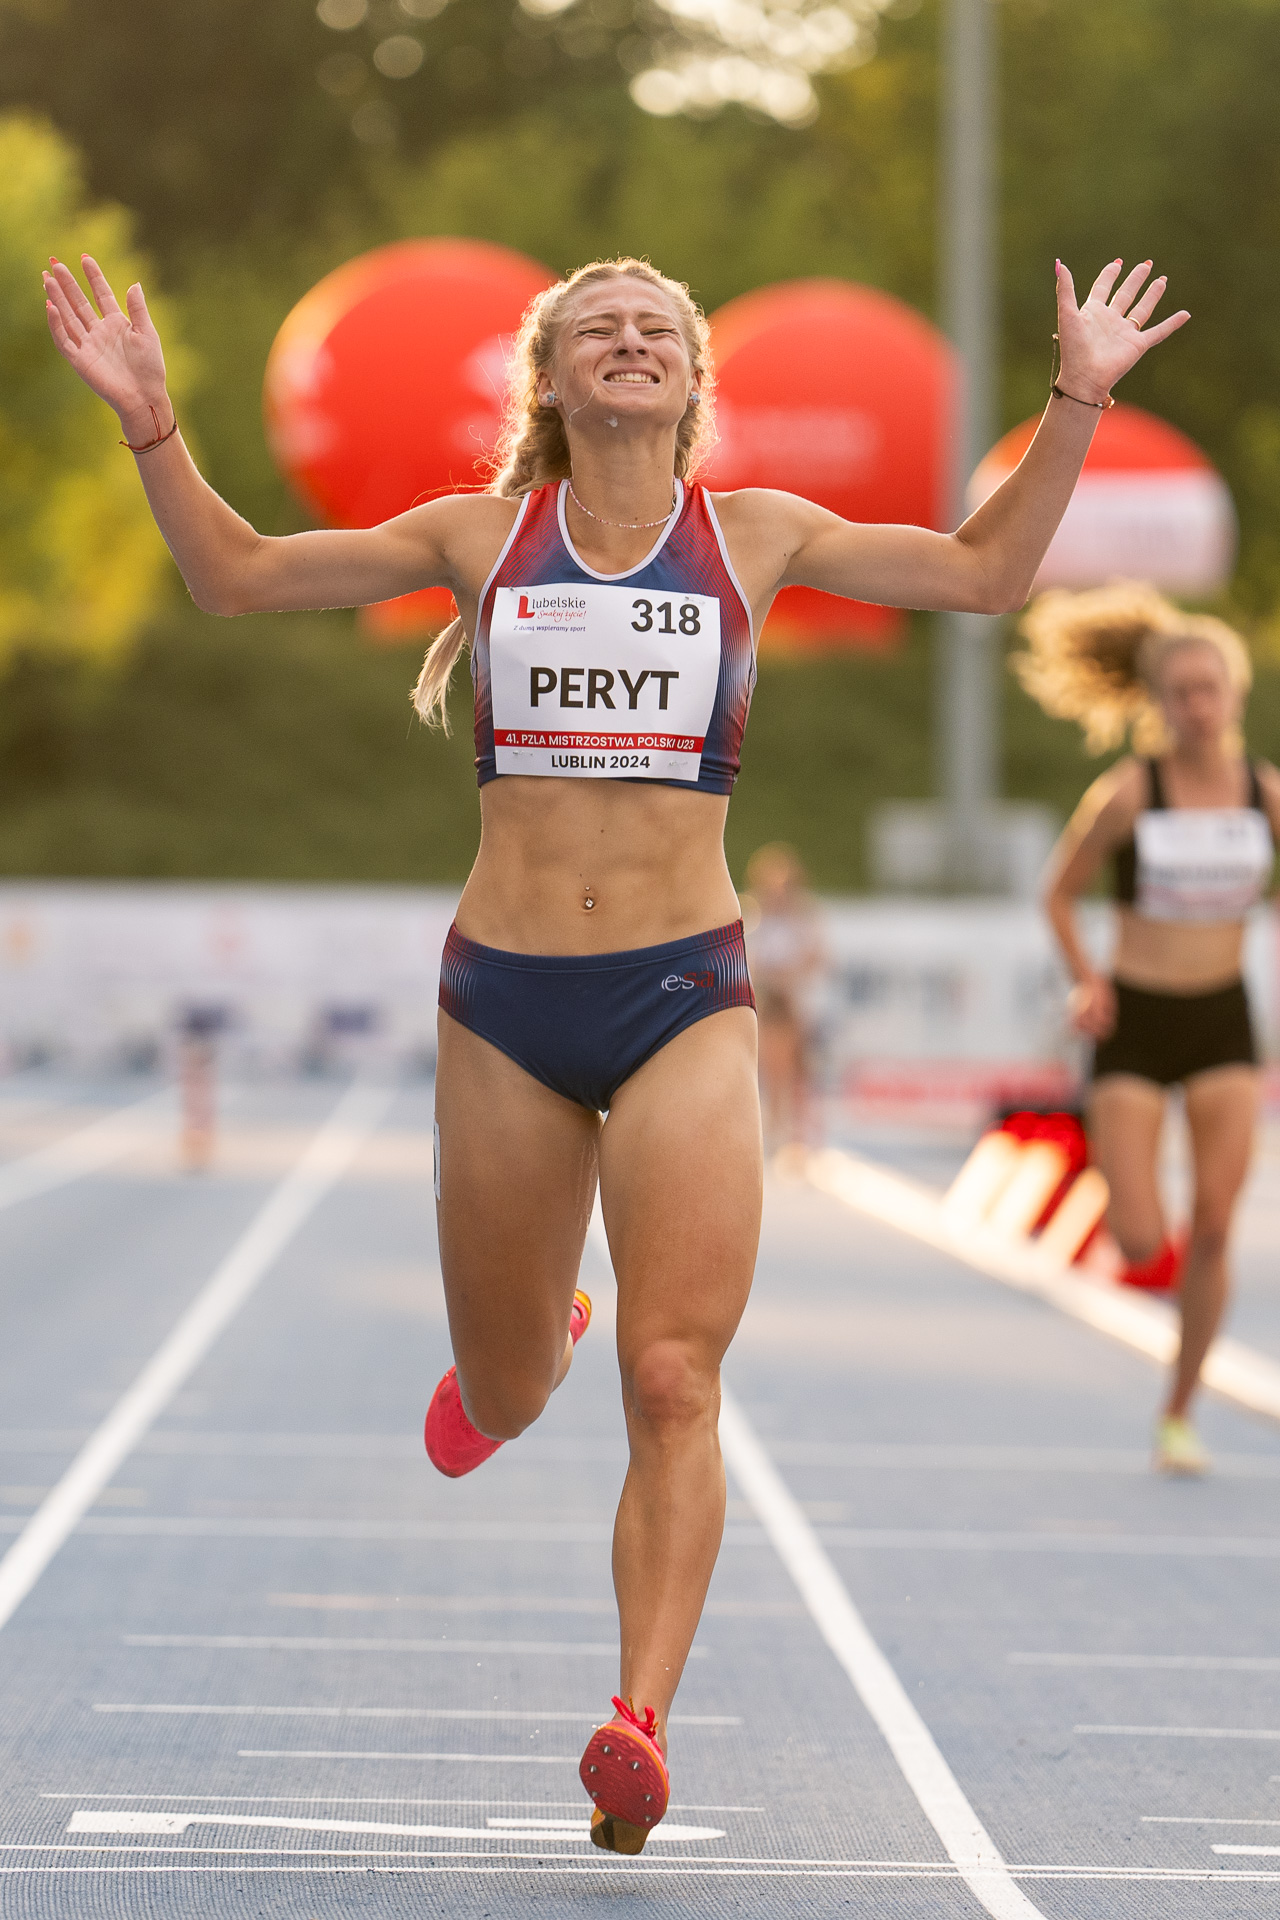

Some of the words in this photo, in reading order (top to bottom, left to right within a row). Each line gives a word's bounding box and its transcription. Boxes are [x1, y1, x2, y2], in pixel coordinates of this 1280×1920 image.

[631, 599, 701, 635] 318
[536, 624, 569, 632] wspieramy
[530, 667, 679, 710] PERYT
[505, 733, 519, 744] 41.
[521, 734, 546, 745] PZLA
[549, 735, 635, 747] MISTRZOSTWA
[637, 736, 675, 748] POLSKI
[677, 738, 695, 750] U23
[551, 755, 606, 769] LUBLIN
[610, 755, 651, 769] 2024
